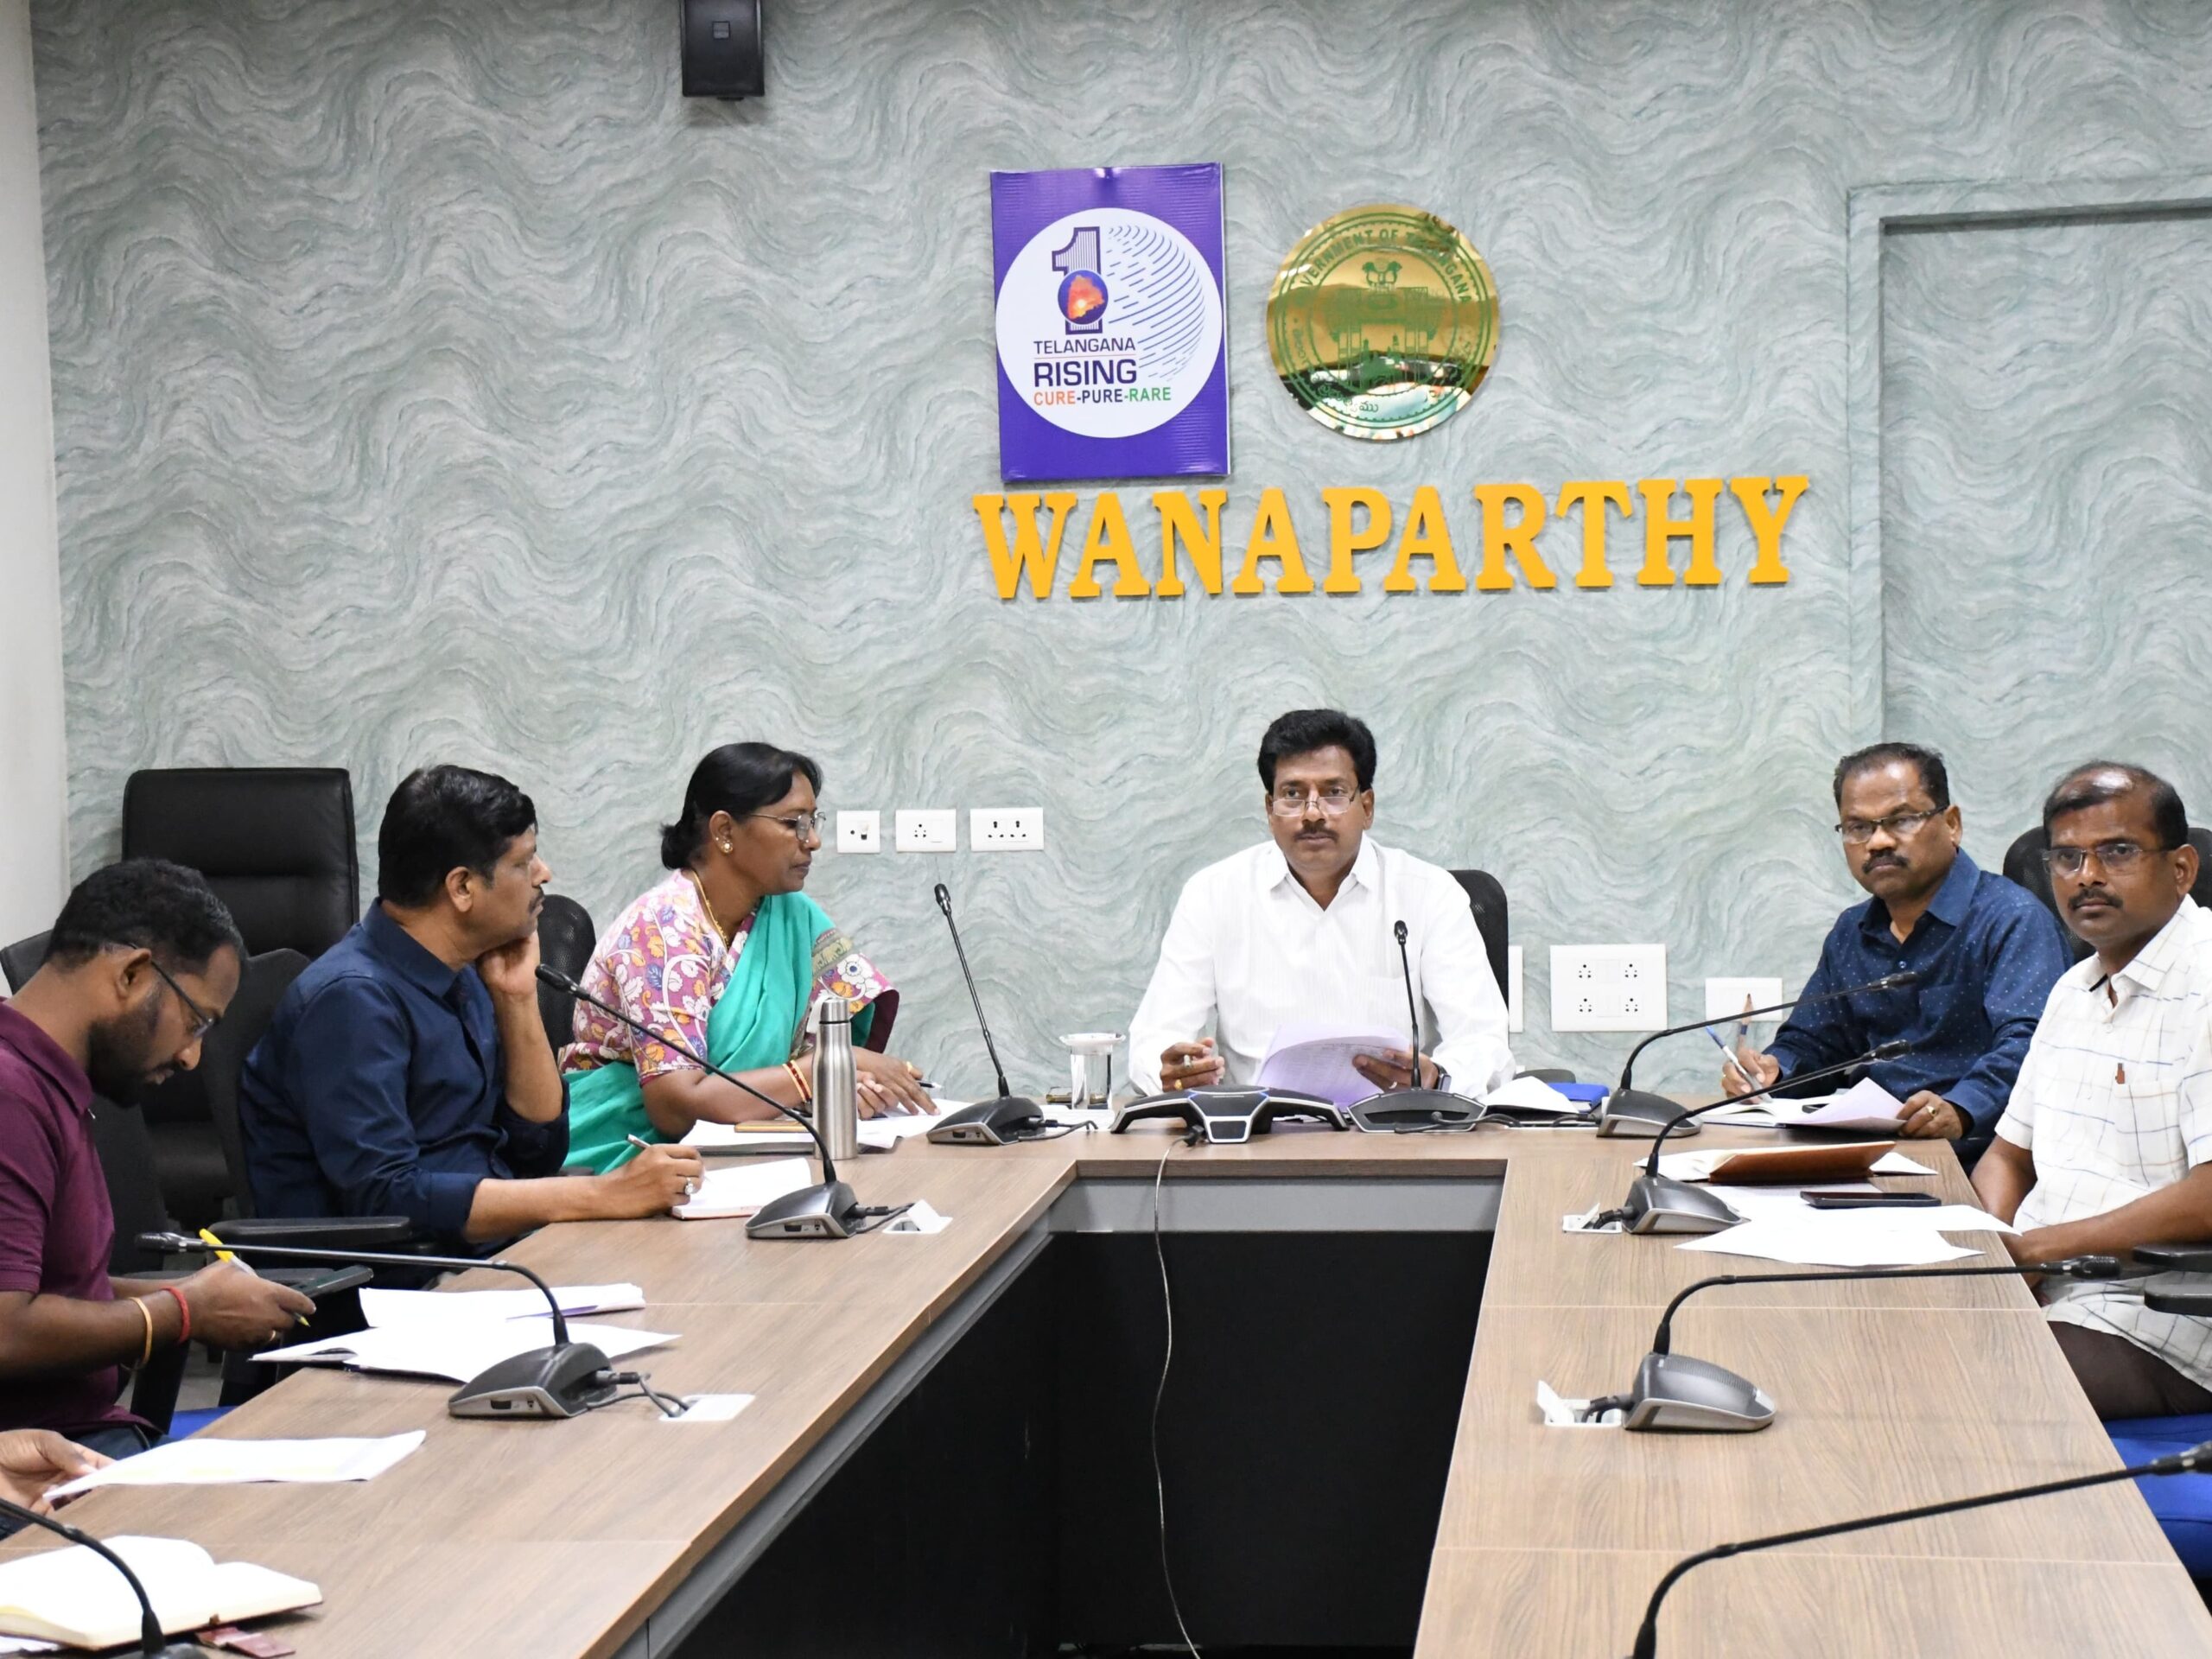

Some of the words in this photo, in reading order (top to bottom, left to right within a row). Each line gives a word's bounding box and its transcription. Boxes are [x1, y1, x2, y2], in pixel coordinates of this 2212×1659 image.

[1297, 229, 1372, 296] VERNMENT
[1379, 228, 1398, 241] OF
[1033, 337, 1136, 355] TELANGANA
[1033, 359, 1137, 388] RISING
[1033, 386, 1172, 406] CURE-PURE-RARE
[974, 476, 1808, 600] WANAPARTHY
